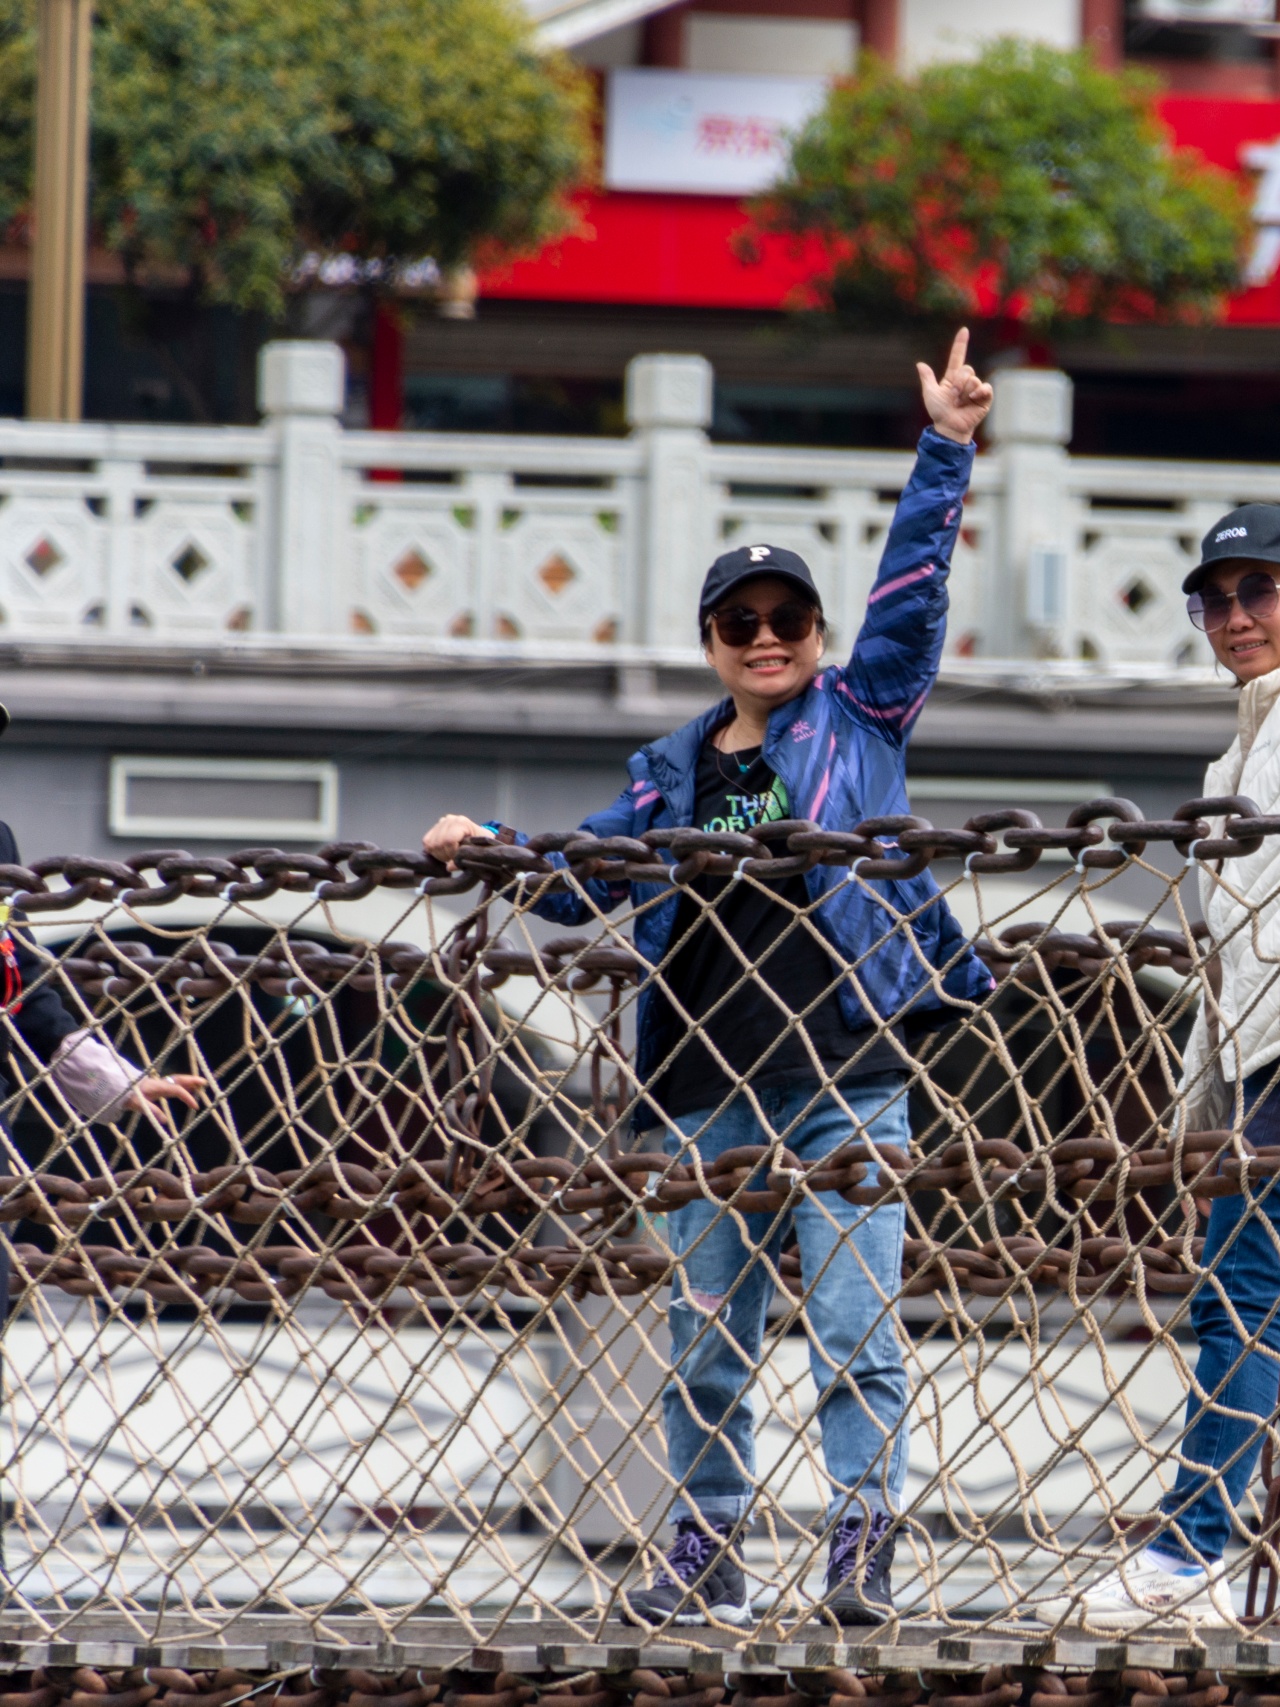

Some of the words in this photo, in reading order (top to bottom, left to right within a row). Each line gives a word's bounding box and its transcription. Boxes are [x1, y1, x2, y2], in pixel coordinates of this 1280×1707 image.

[749, 546, 771, 561] P
[726, 793, 767, 816] TH
[703, 808, 759, 833] ORT
